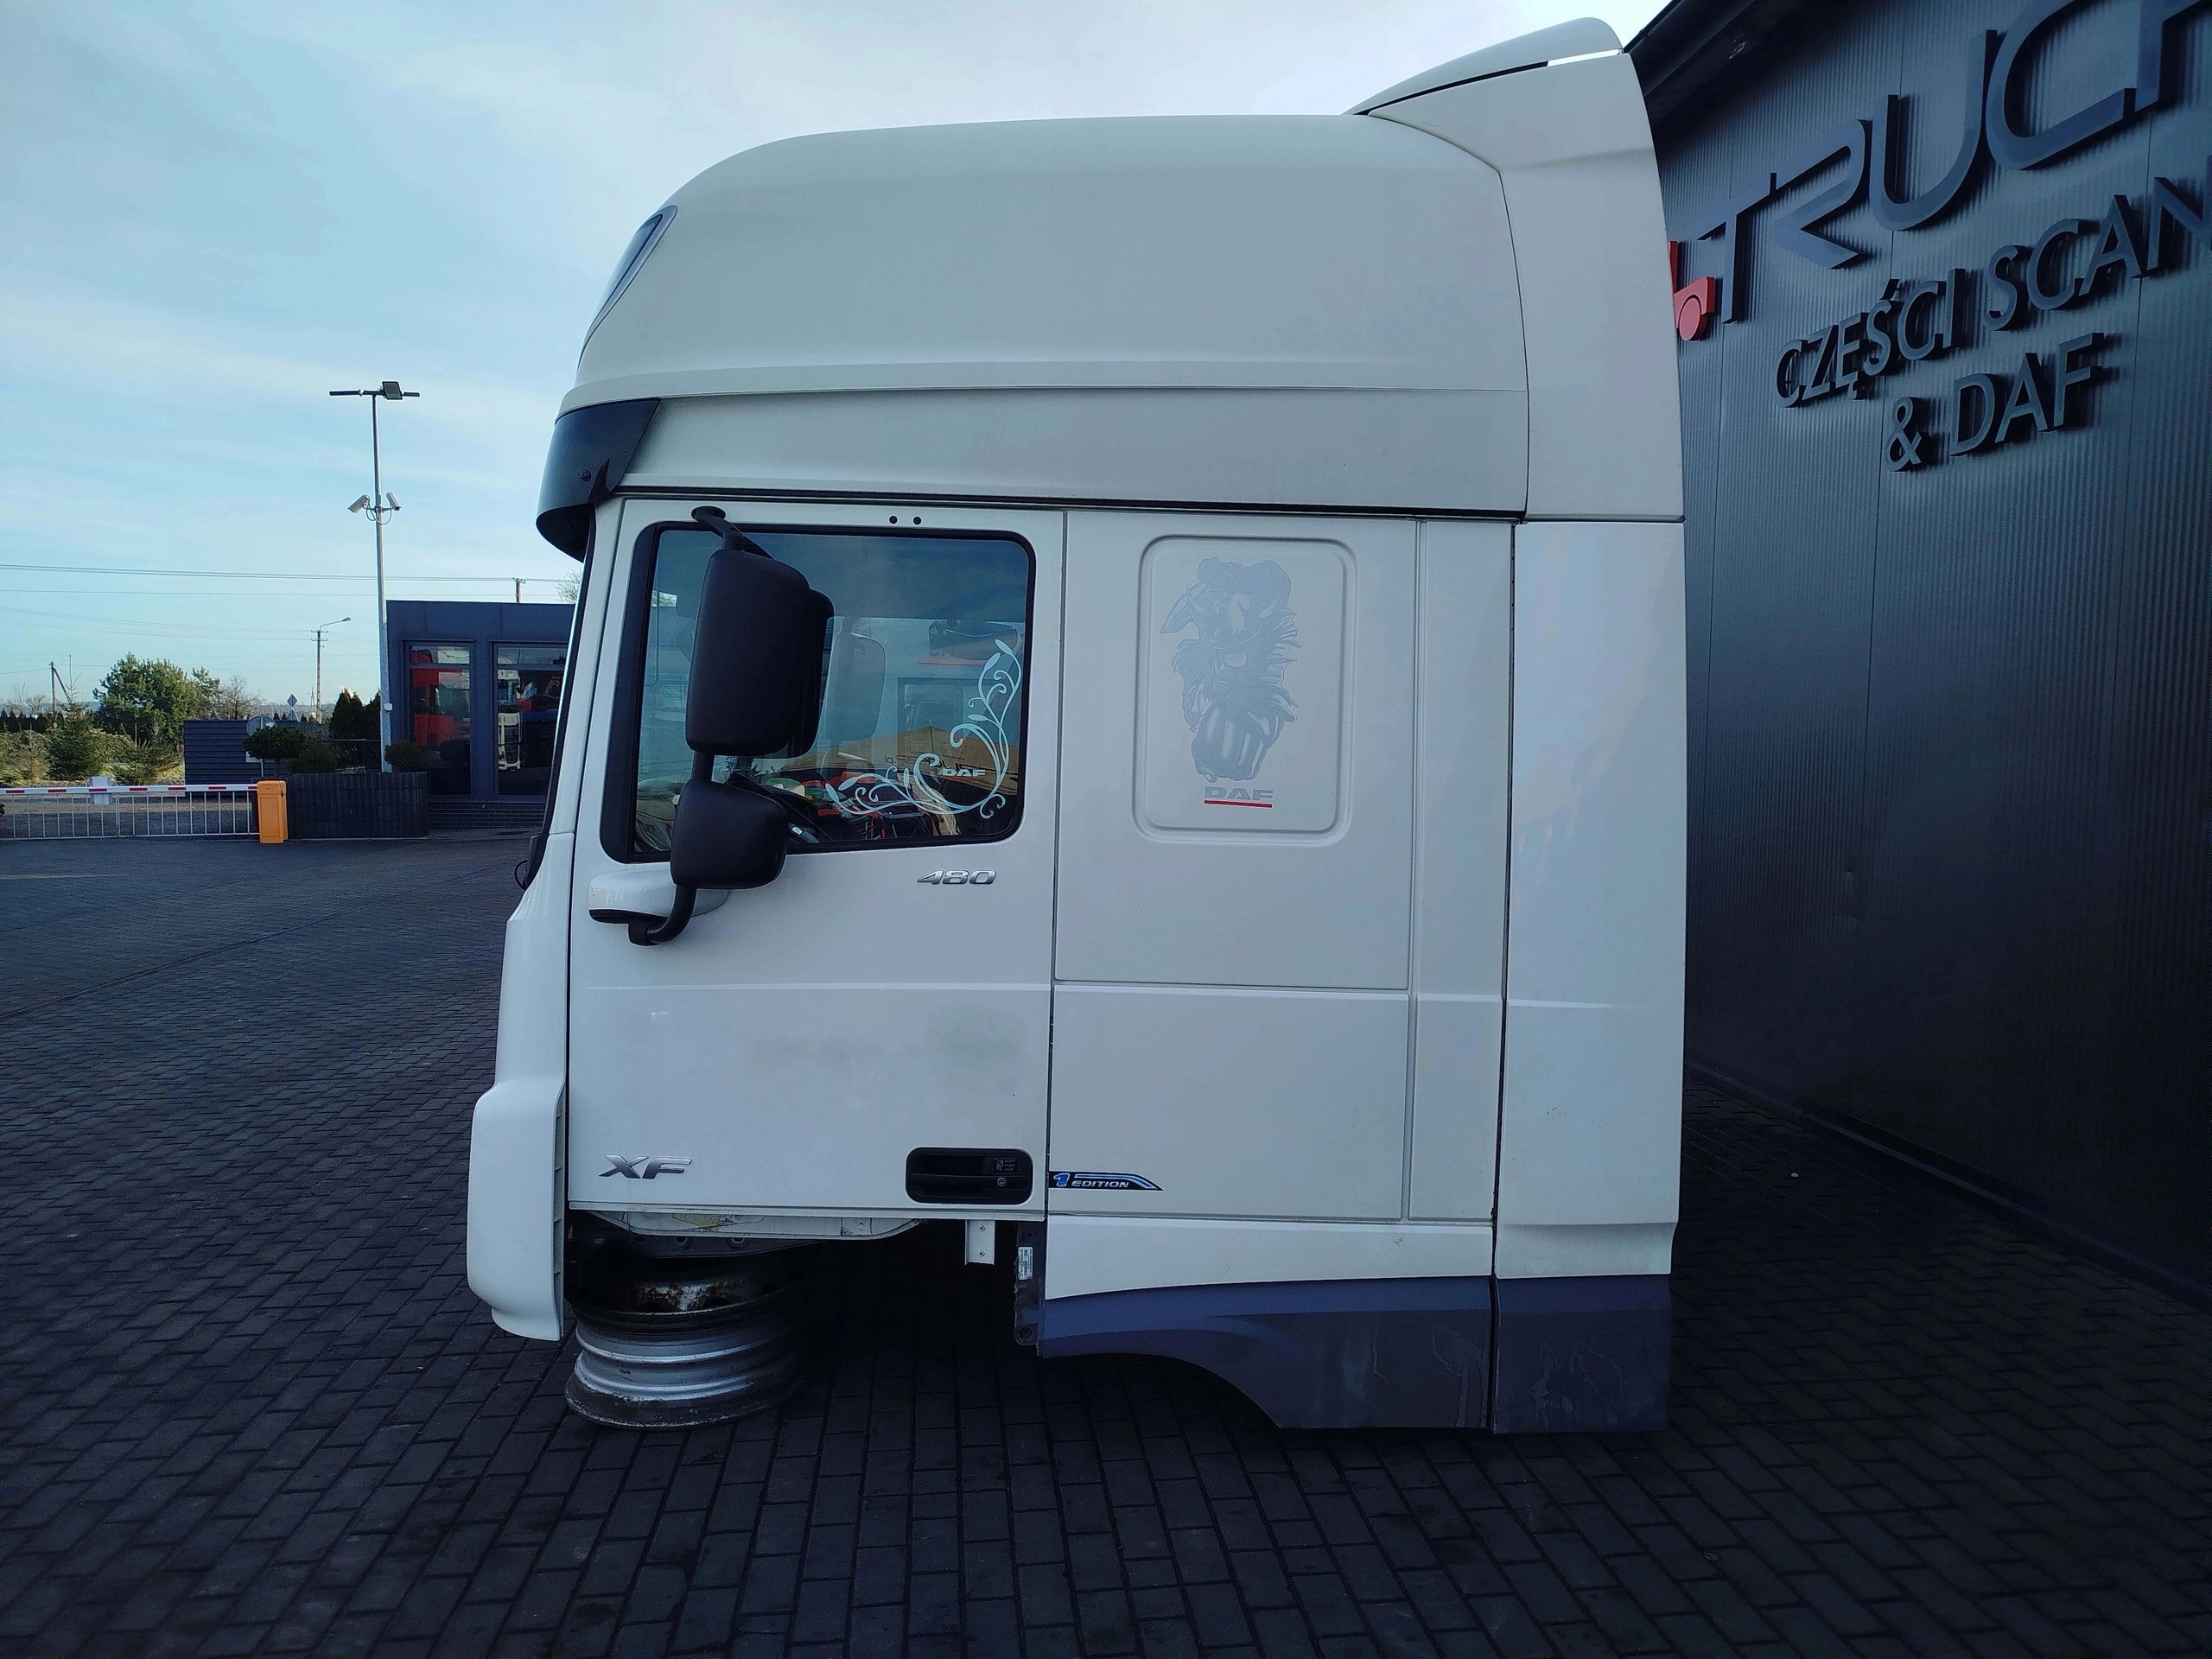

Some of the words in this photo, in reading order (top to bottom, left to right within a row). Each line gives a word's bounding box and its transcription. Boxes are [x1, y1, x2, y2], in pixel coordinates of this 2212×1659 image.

[1695, 0, 2202, 325] TRUC
[1776, 268, 1964, 408] CZĘŚCI
[1885, 397, 1923, 473] &
[1950, 333, 2104, 458] DAF
[941, 768, 987, 777] DAF
[1204, 785, 1274, 801] DAF
[916, 869, 997, 886] 480
[598, 1154, 692, 1179] XF
[1052, 1172, 1071, 1188] 1
[1071, 1179, 1130, 1189] EDITION
